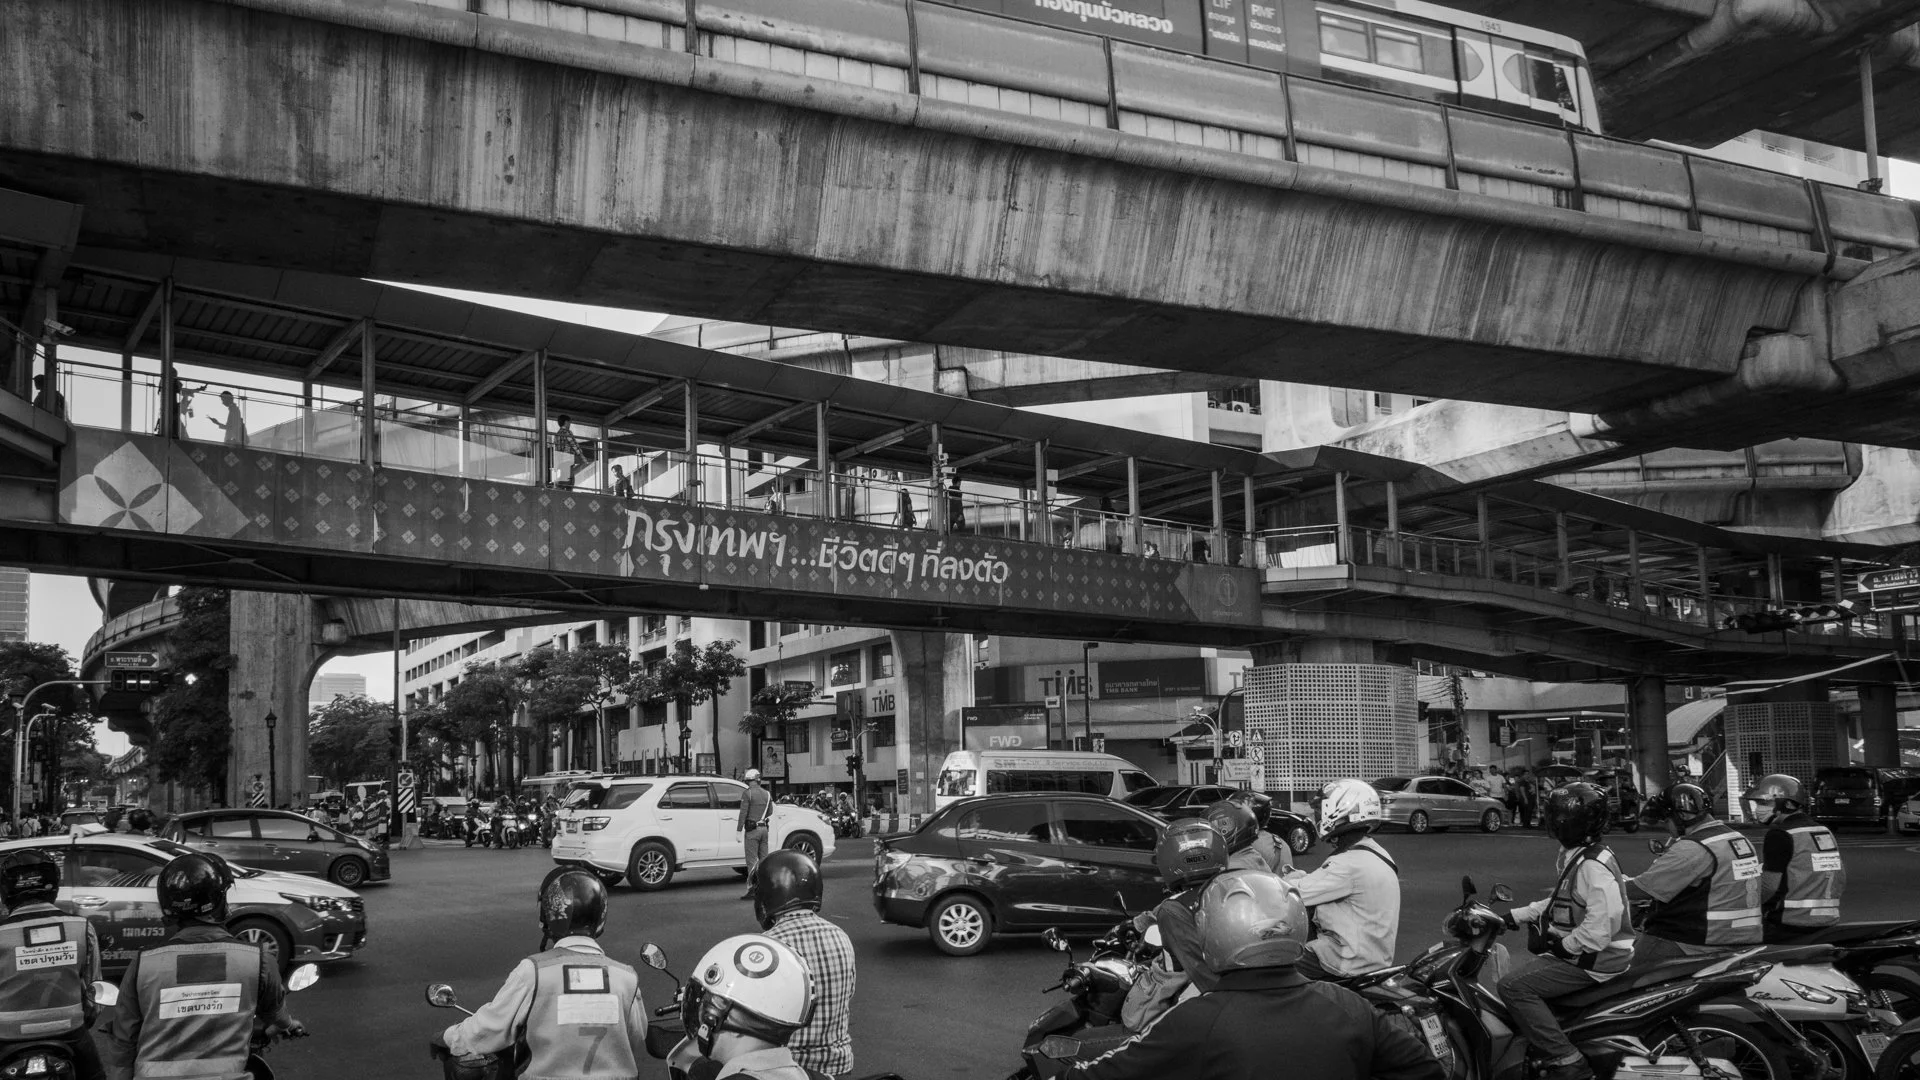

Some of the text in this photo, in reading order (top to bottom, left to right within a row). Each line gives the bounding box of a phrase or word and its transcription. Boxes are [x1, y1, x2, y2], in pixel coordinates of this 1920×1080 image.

[1250, 4, 1277, 19] RMF
[1480, 19, 1502, 32] 1943
[921, 540, 1009, 584] ที่ลงตัว
[1038, 669, 1093, 697] TMB
[871, 689, 896, 713] TMB
[989, 736, 1022, 748] FWD
[177, 1000, 223, 1014] เขตบางรัก
[578, 1026, 608, 1076] 7
